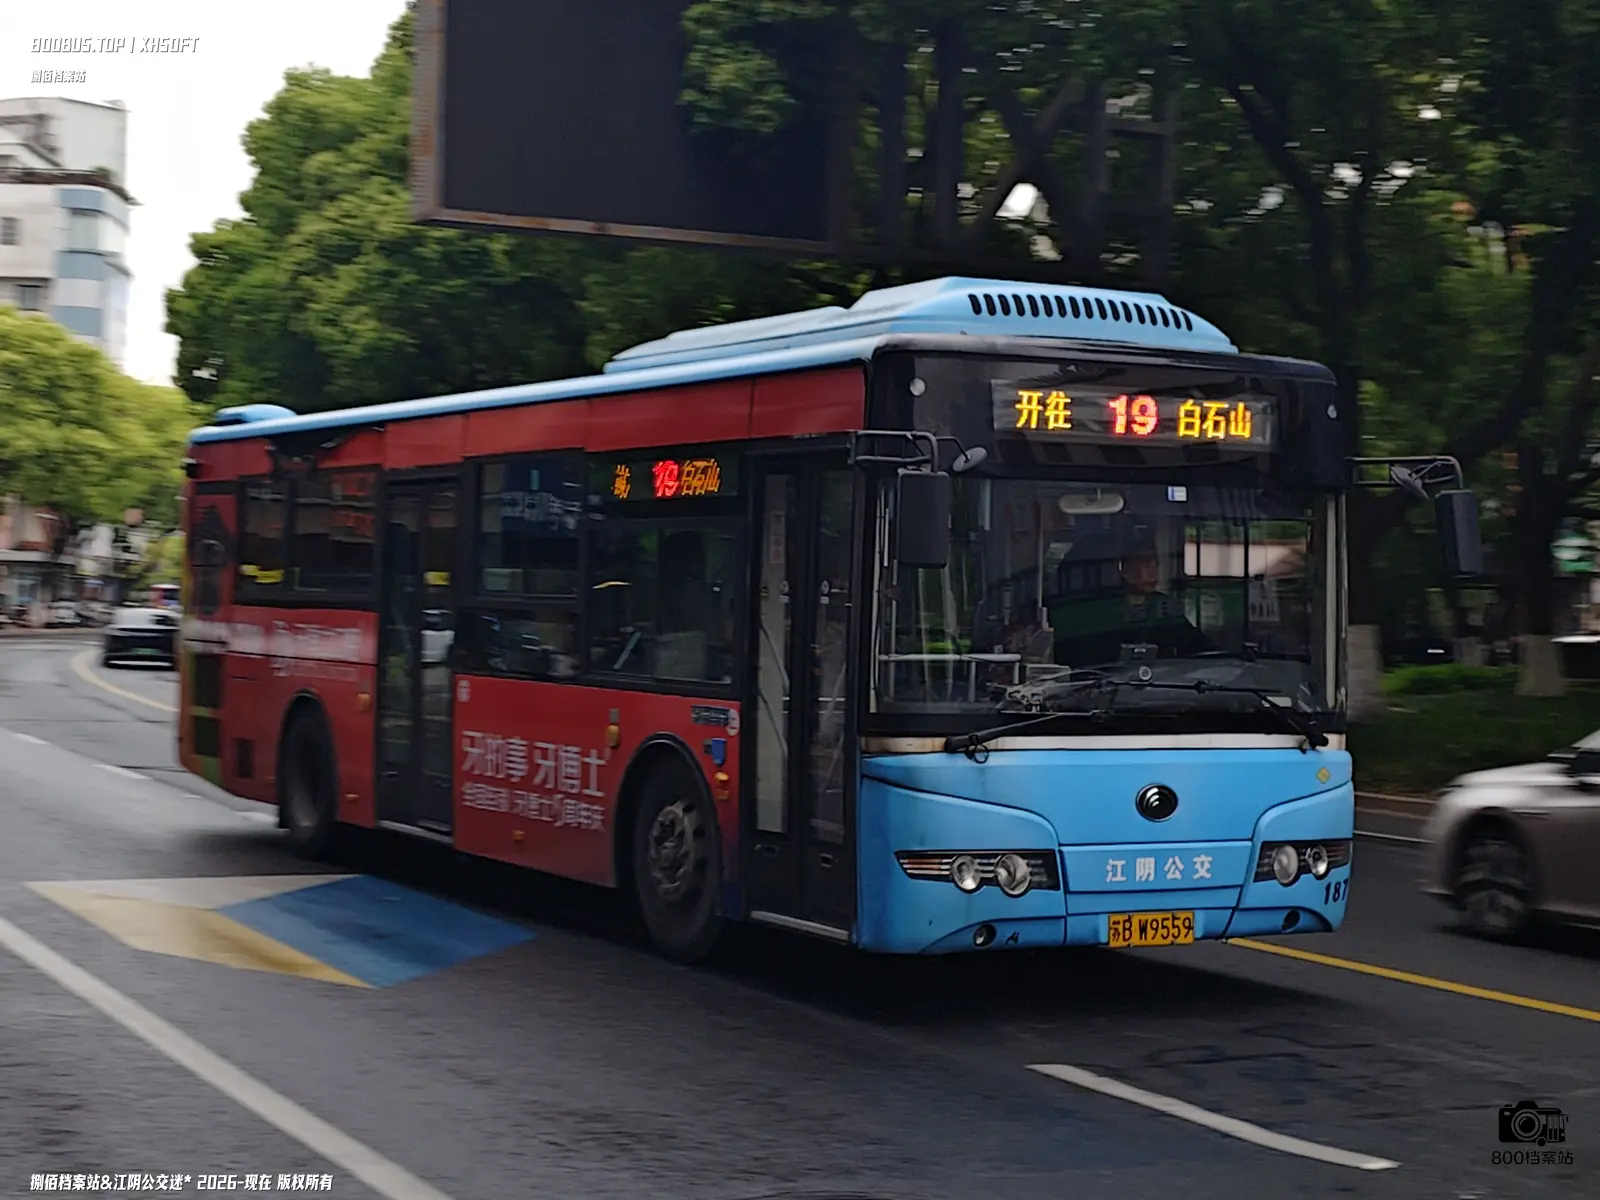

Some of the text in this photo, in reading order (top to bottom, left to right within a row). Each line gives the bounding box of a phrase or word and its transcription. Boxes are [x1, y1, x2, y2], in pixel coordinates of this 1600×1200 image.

[1015, 390, 1252, 439] 开往 19 白石山
[1105, 854, 1213, 883] 江阴公交
[1138, 916, 1192, 941] W9559
